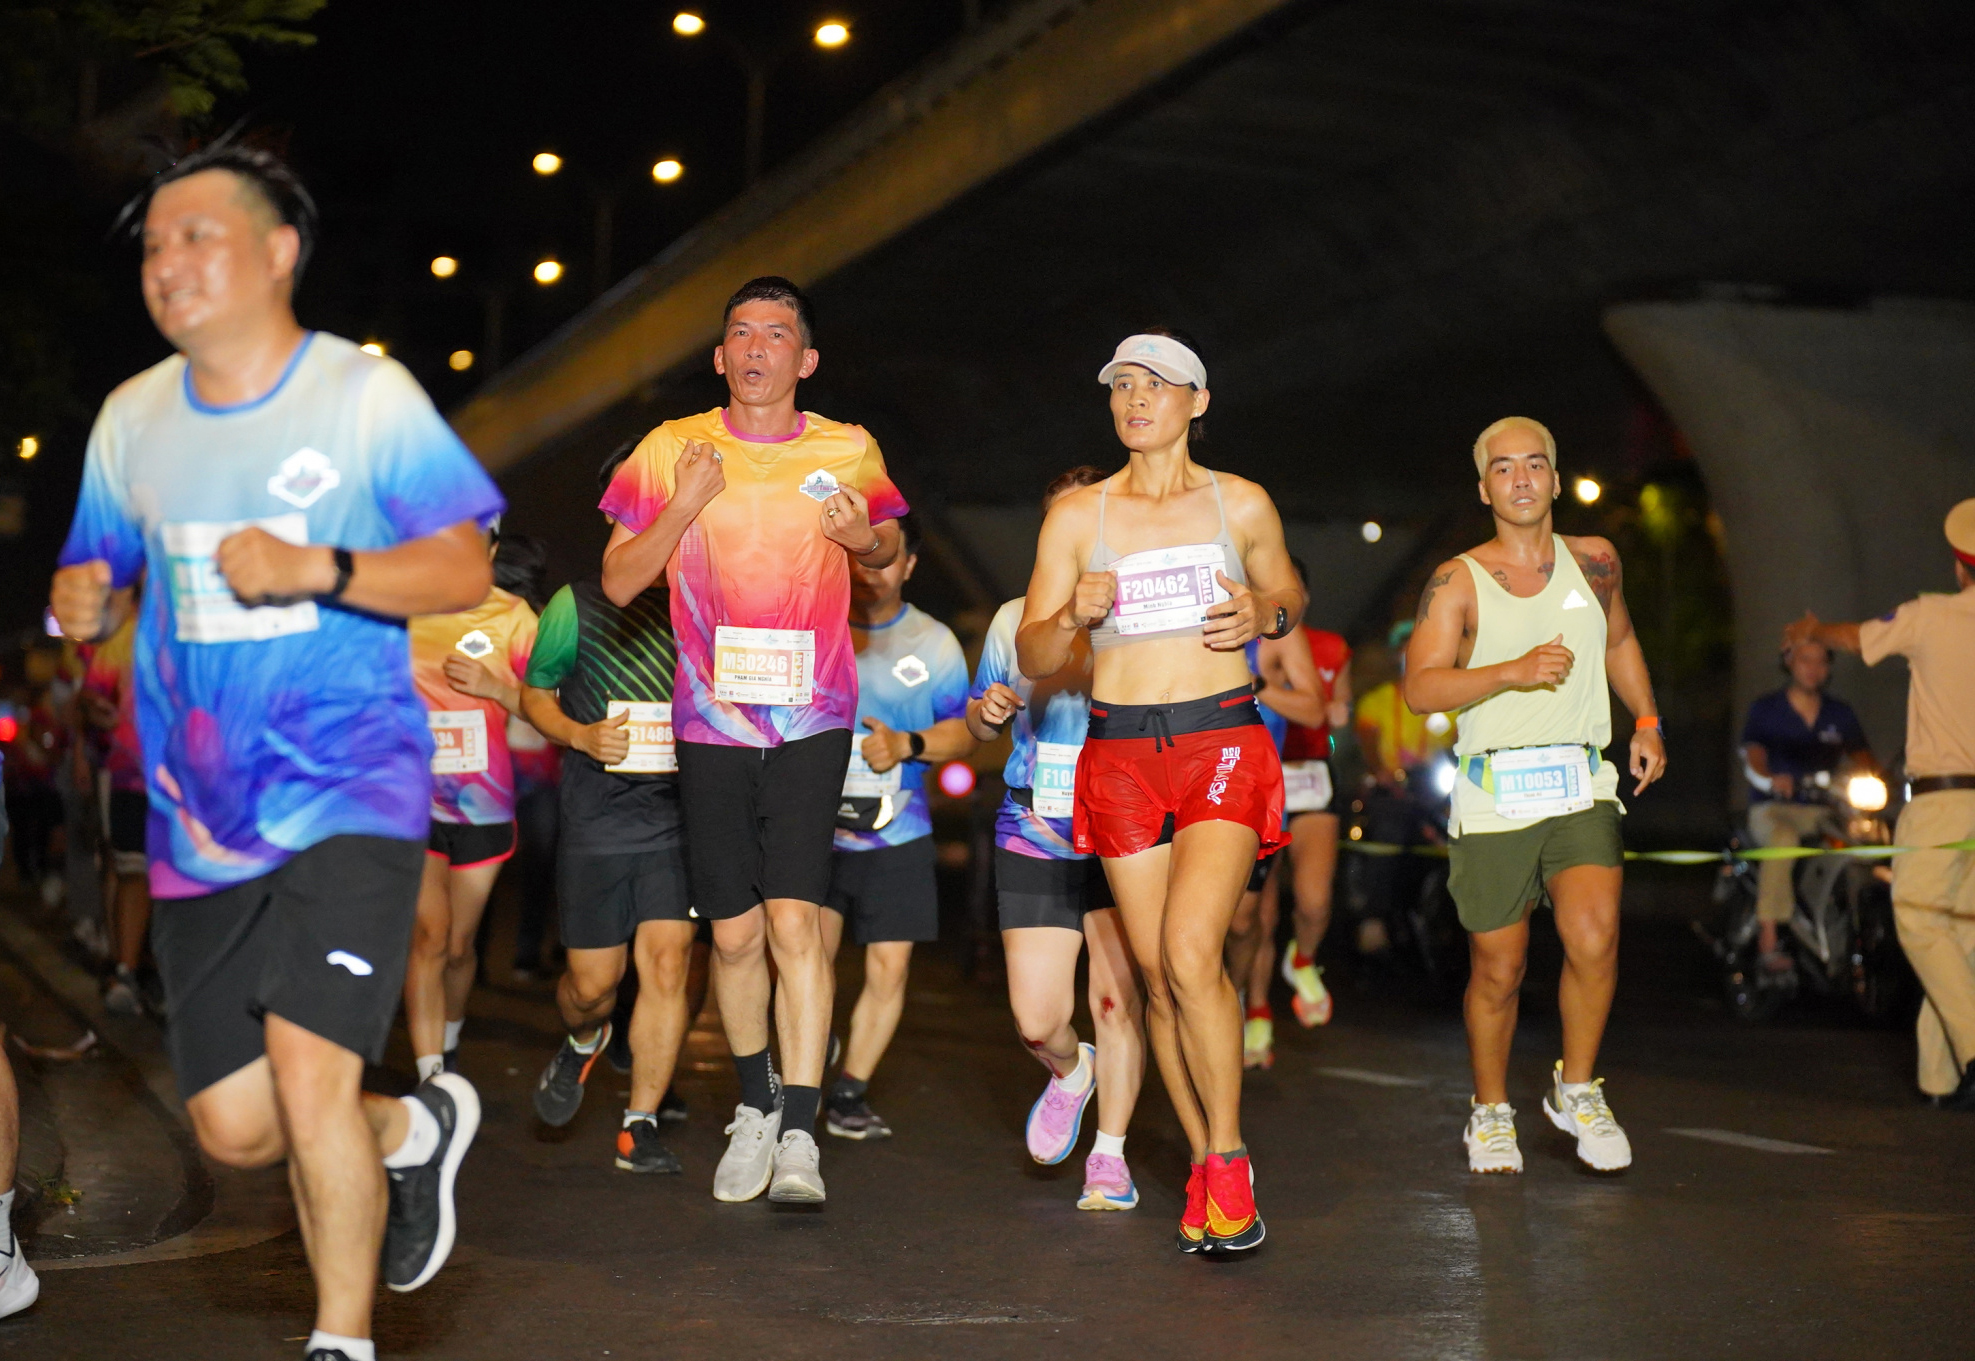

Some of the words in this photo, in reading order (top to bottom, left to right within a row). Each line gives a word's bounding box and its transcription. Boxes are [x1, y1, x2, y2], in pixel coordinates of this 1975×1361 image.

[1120, 573, 1190, 601] F20462
[1200, 567, 1213, 603] 21KM
[722, 652, 787, 673] M50246
[794, 653, 803, 687] 5KM
[1500, 770, 1563, 792] M10053
